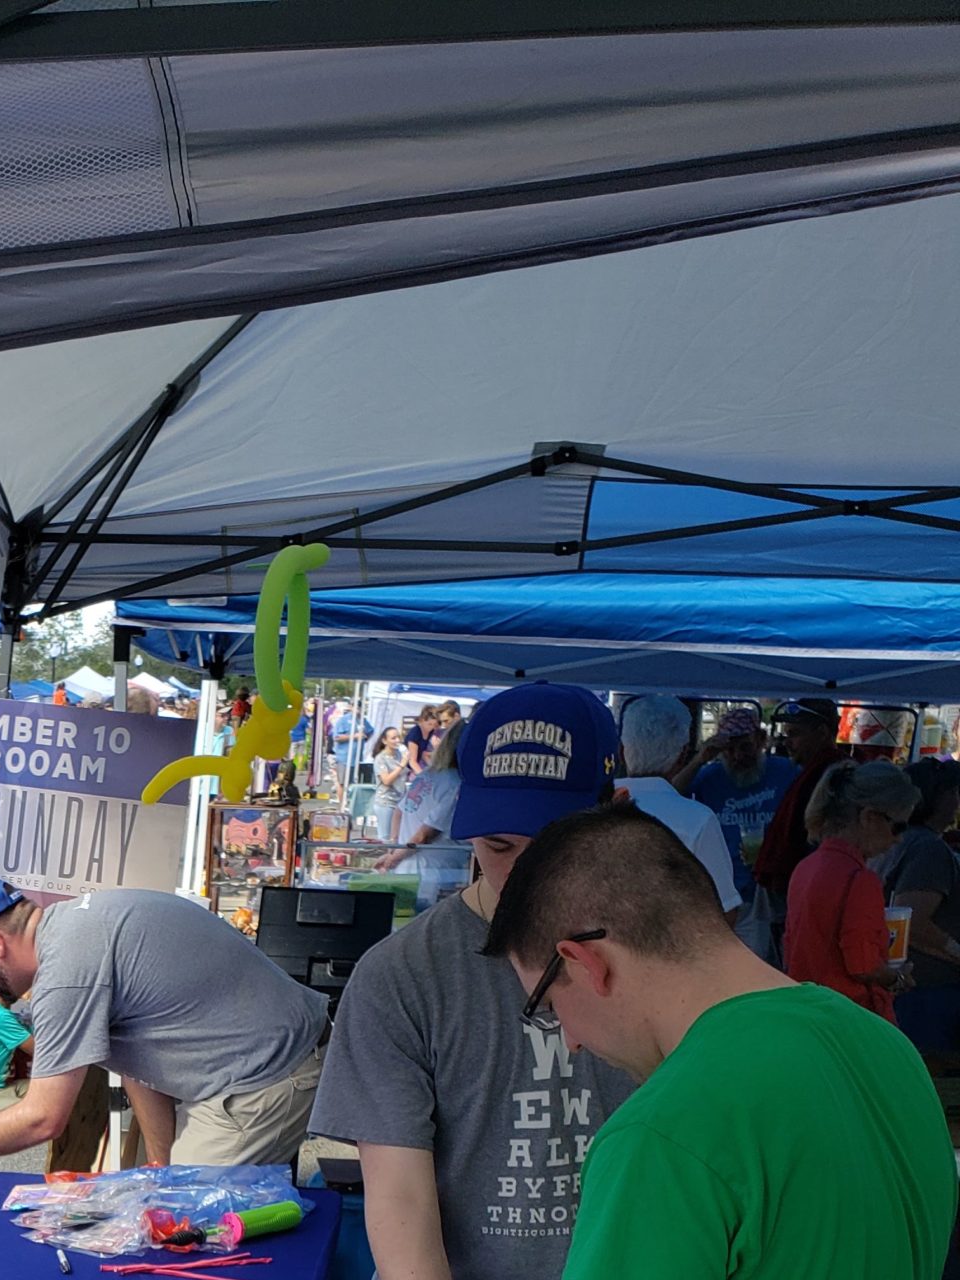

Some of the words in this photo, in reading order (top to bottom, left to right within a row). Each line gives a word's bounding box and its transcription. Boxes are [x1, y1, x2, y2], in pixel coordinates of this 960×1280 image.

[93, 725, 132, 755] 10
[484, 719, 572, 758] PENSACOLA
[483, 752, 569, 780] CHRISTIAN
[717, 810, 777, 827] MEDALLION
[47, 881, 72, 892] OUR
[523, 1023, 573, 1080] W
